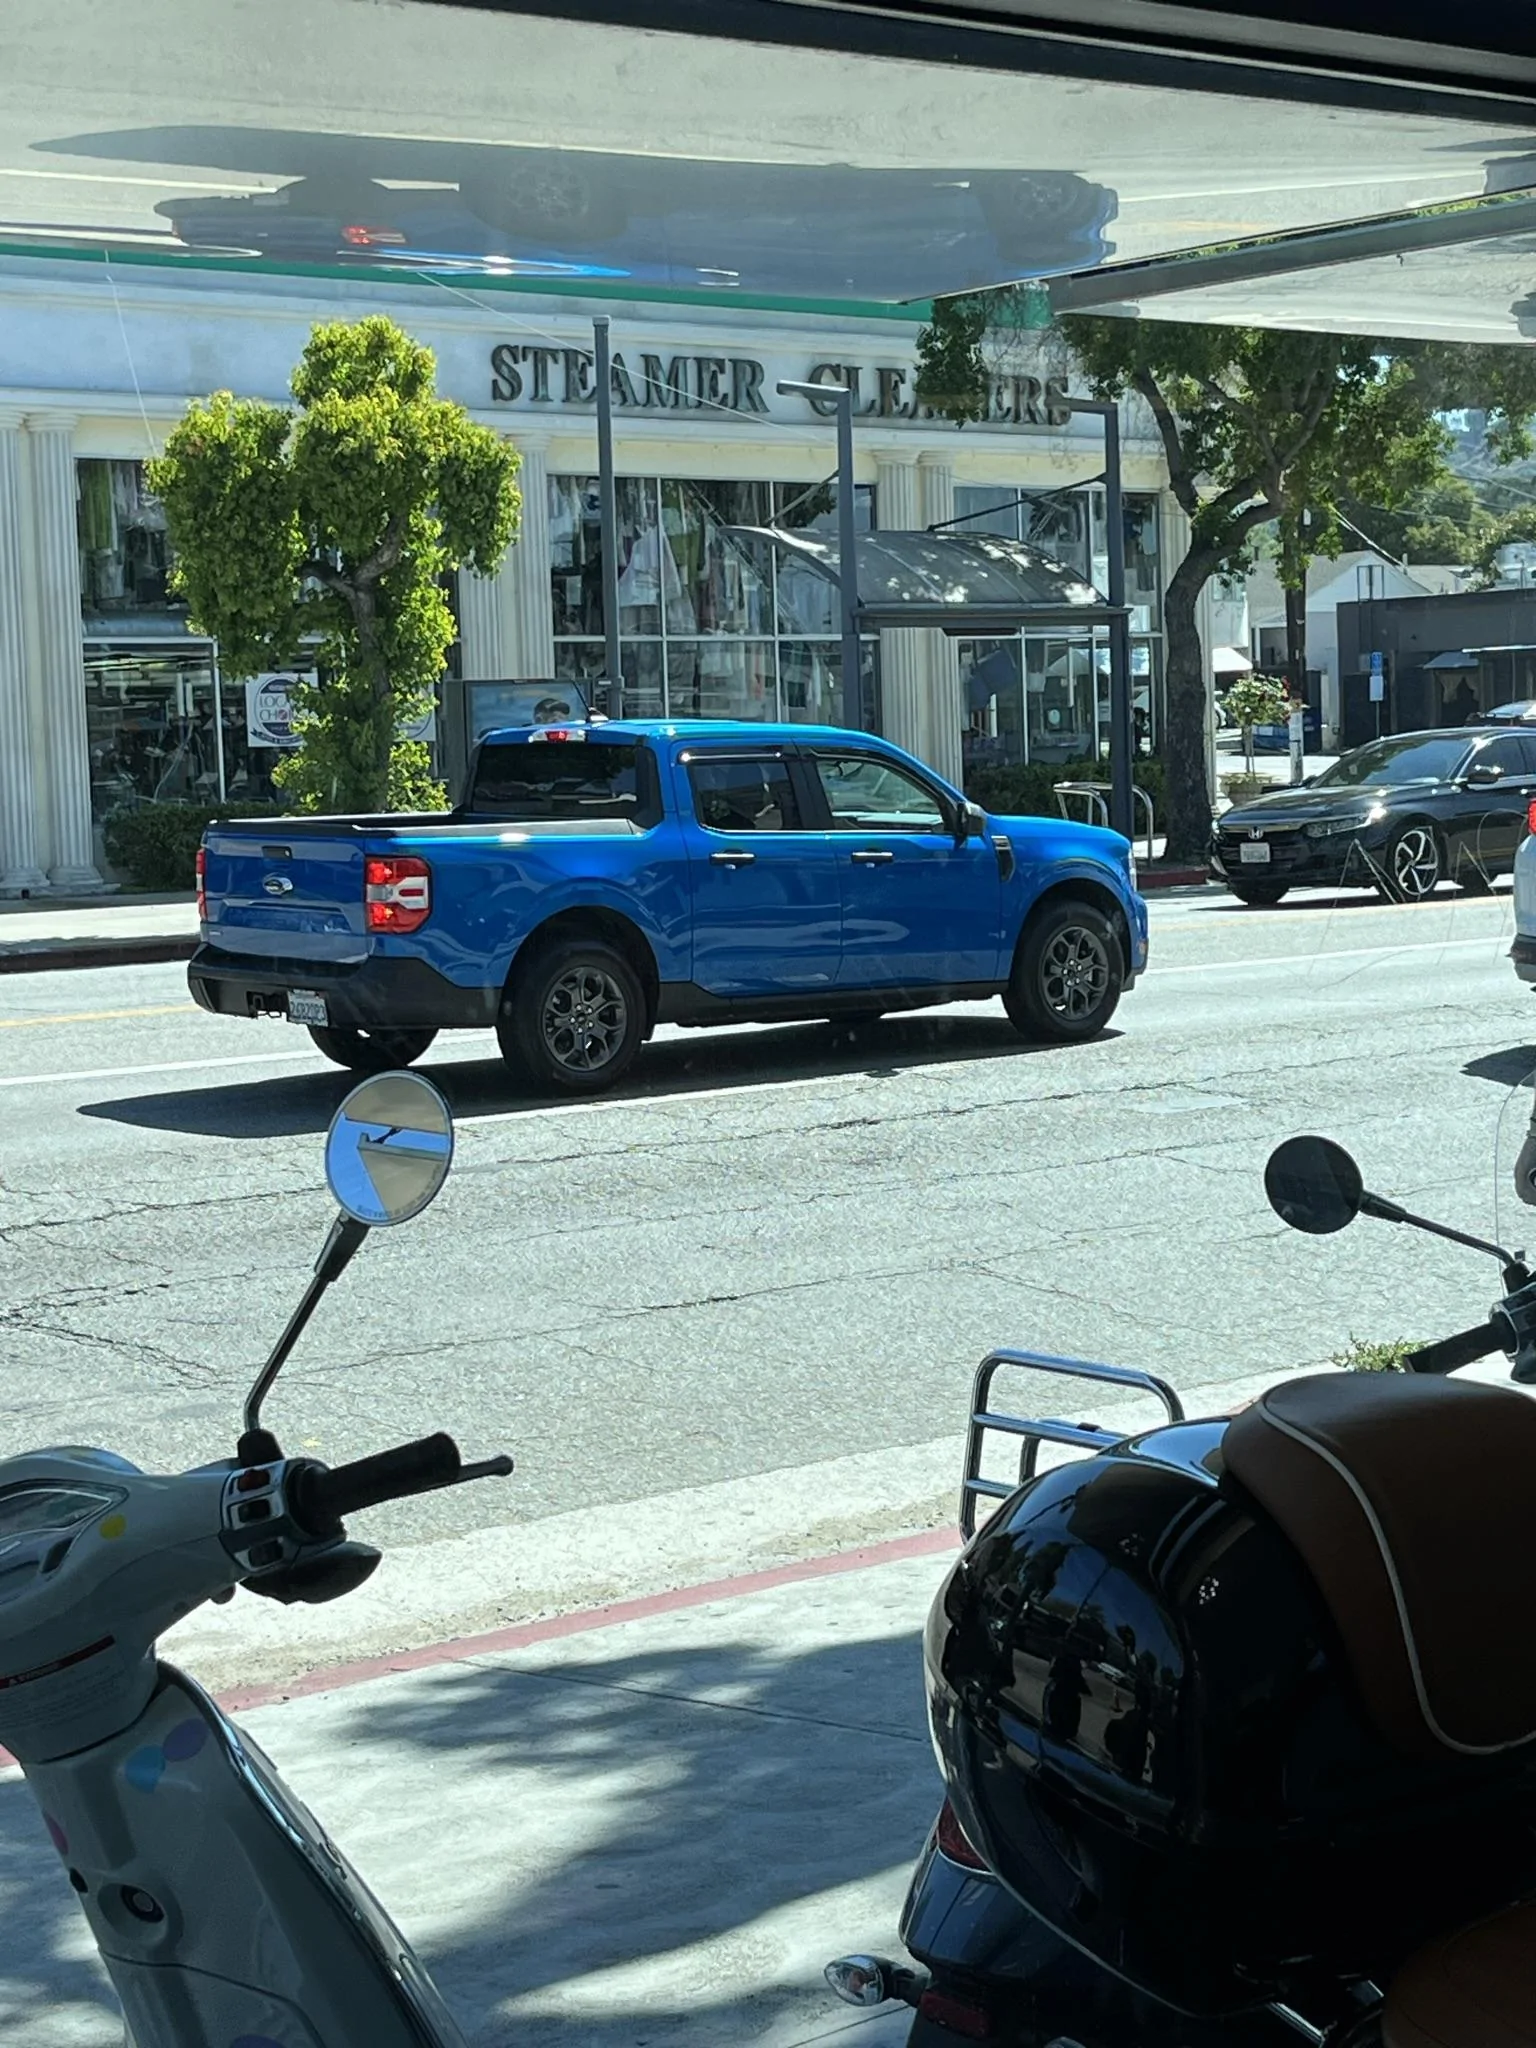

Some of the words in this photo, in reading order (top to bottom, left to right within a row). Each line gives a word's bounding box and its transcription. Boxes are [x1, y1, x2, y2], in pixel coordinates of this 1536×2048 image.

[490, 343, 770, 413] STEAMER
[808, 363, 1072, 425] CLEERS
[259, 695, 287, 708] LOC
